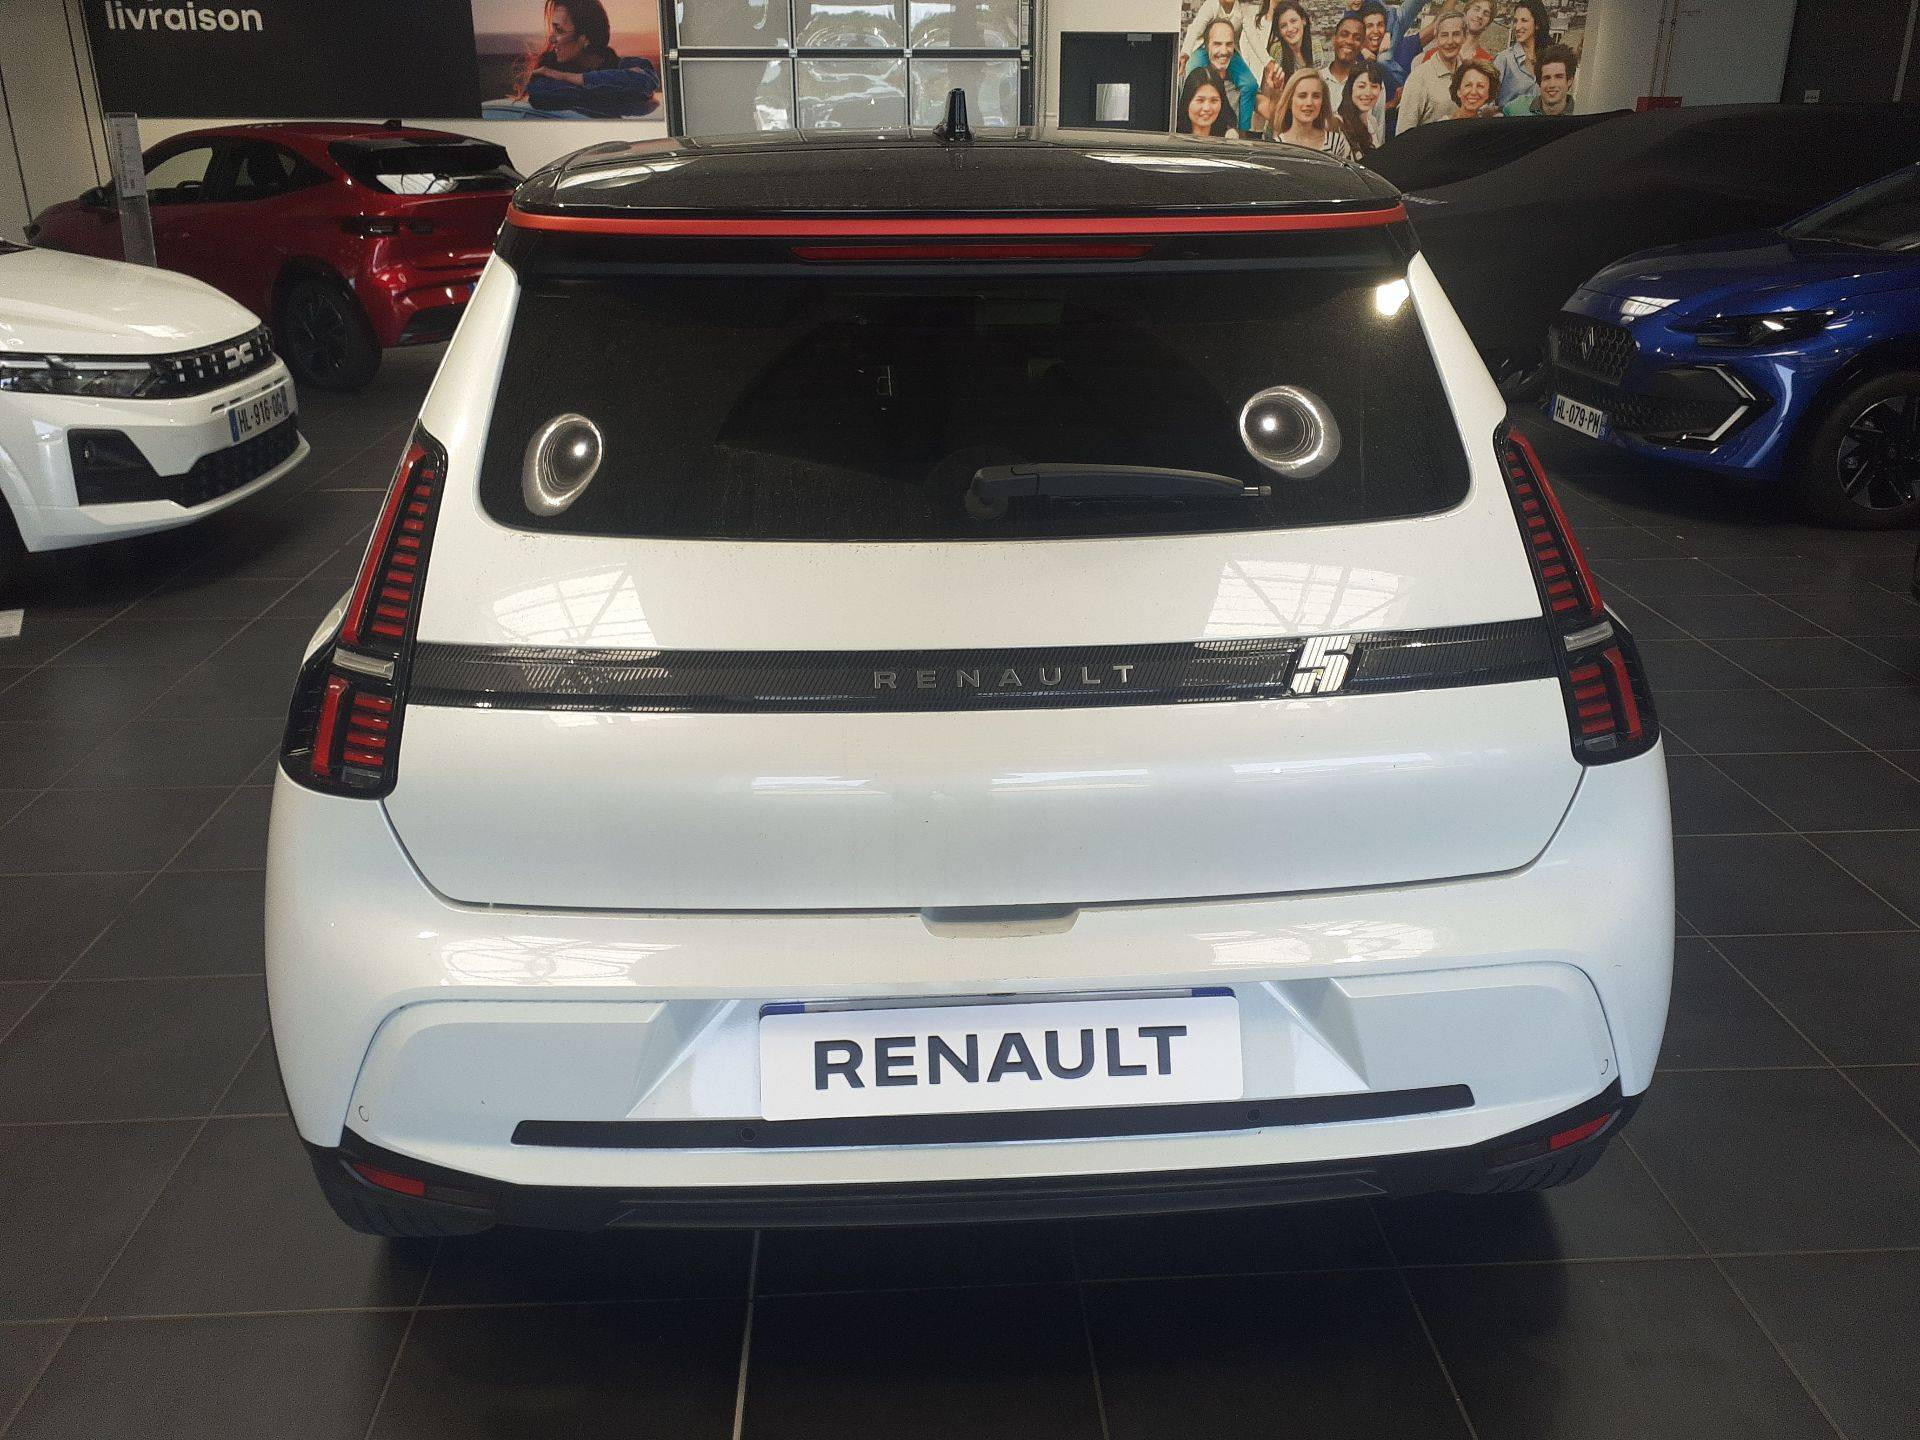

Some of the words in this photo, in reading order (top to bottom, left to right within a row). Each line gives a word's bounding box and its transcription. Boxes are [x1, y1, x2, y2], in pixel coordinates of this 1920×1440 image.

[104, 0, 264, 31] livraison
[873, 664, 1134, 690] RENAULT
[1290, 634, 1352, 694] 5
[814, 1025, 1188, 1091] RENAULT
